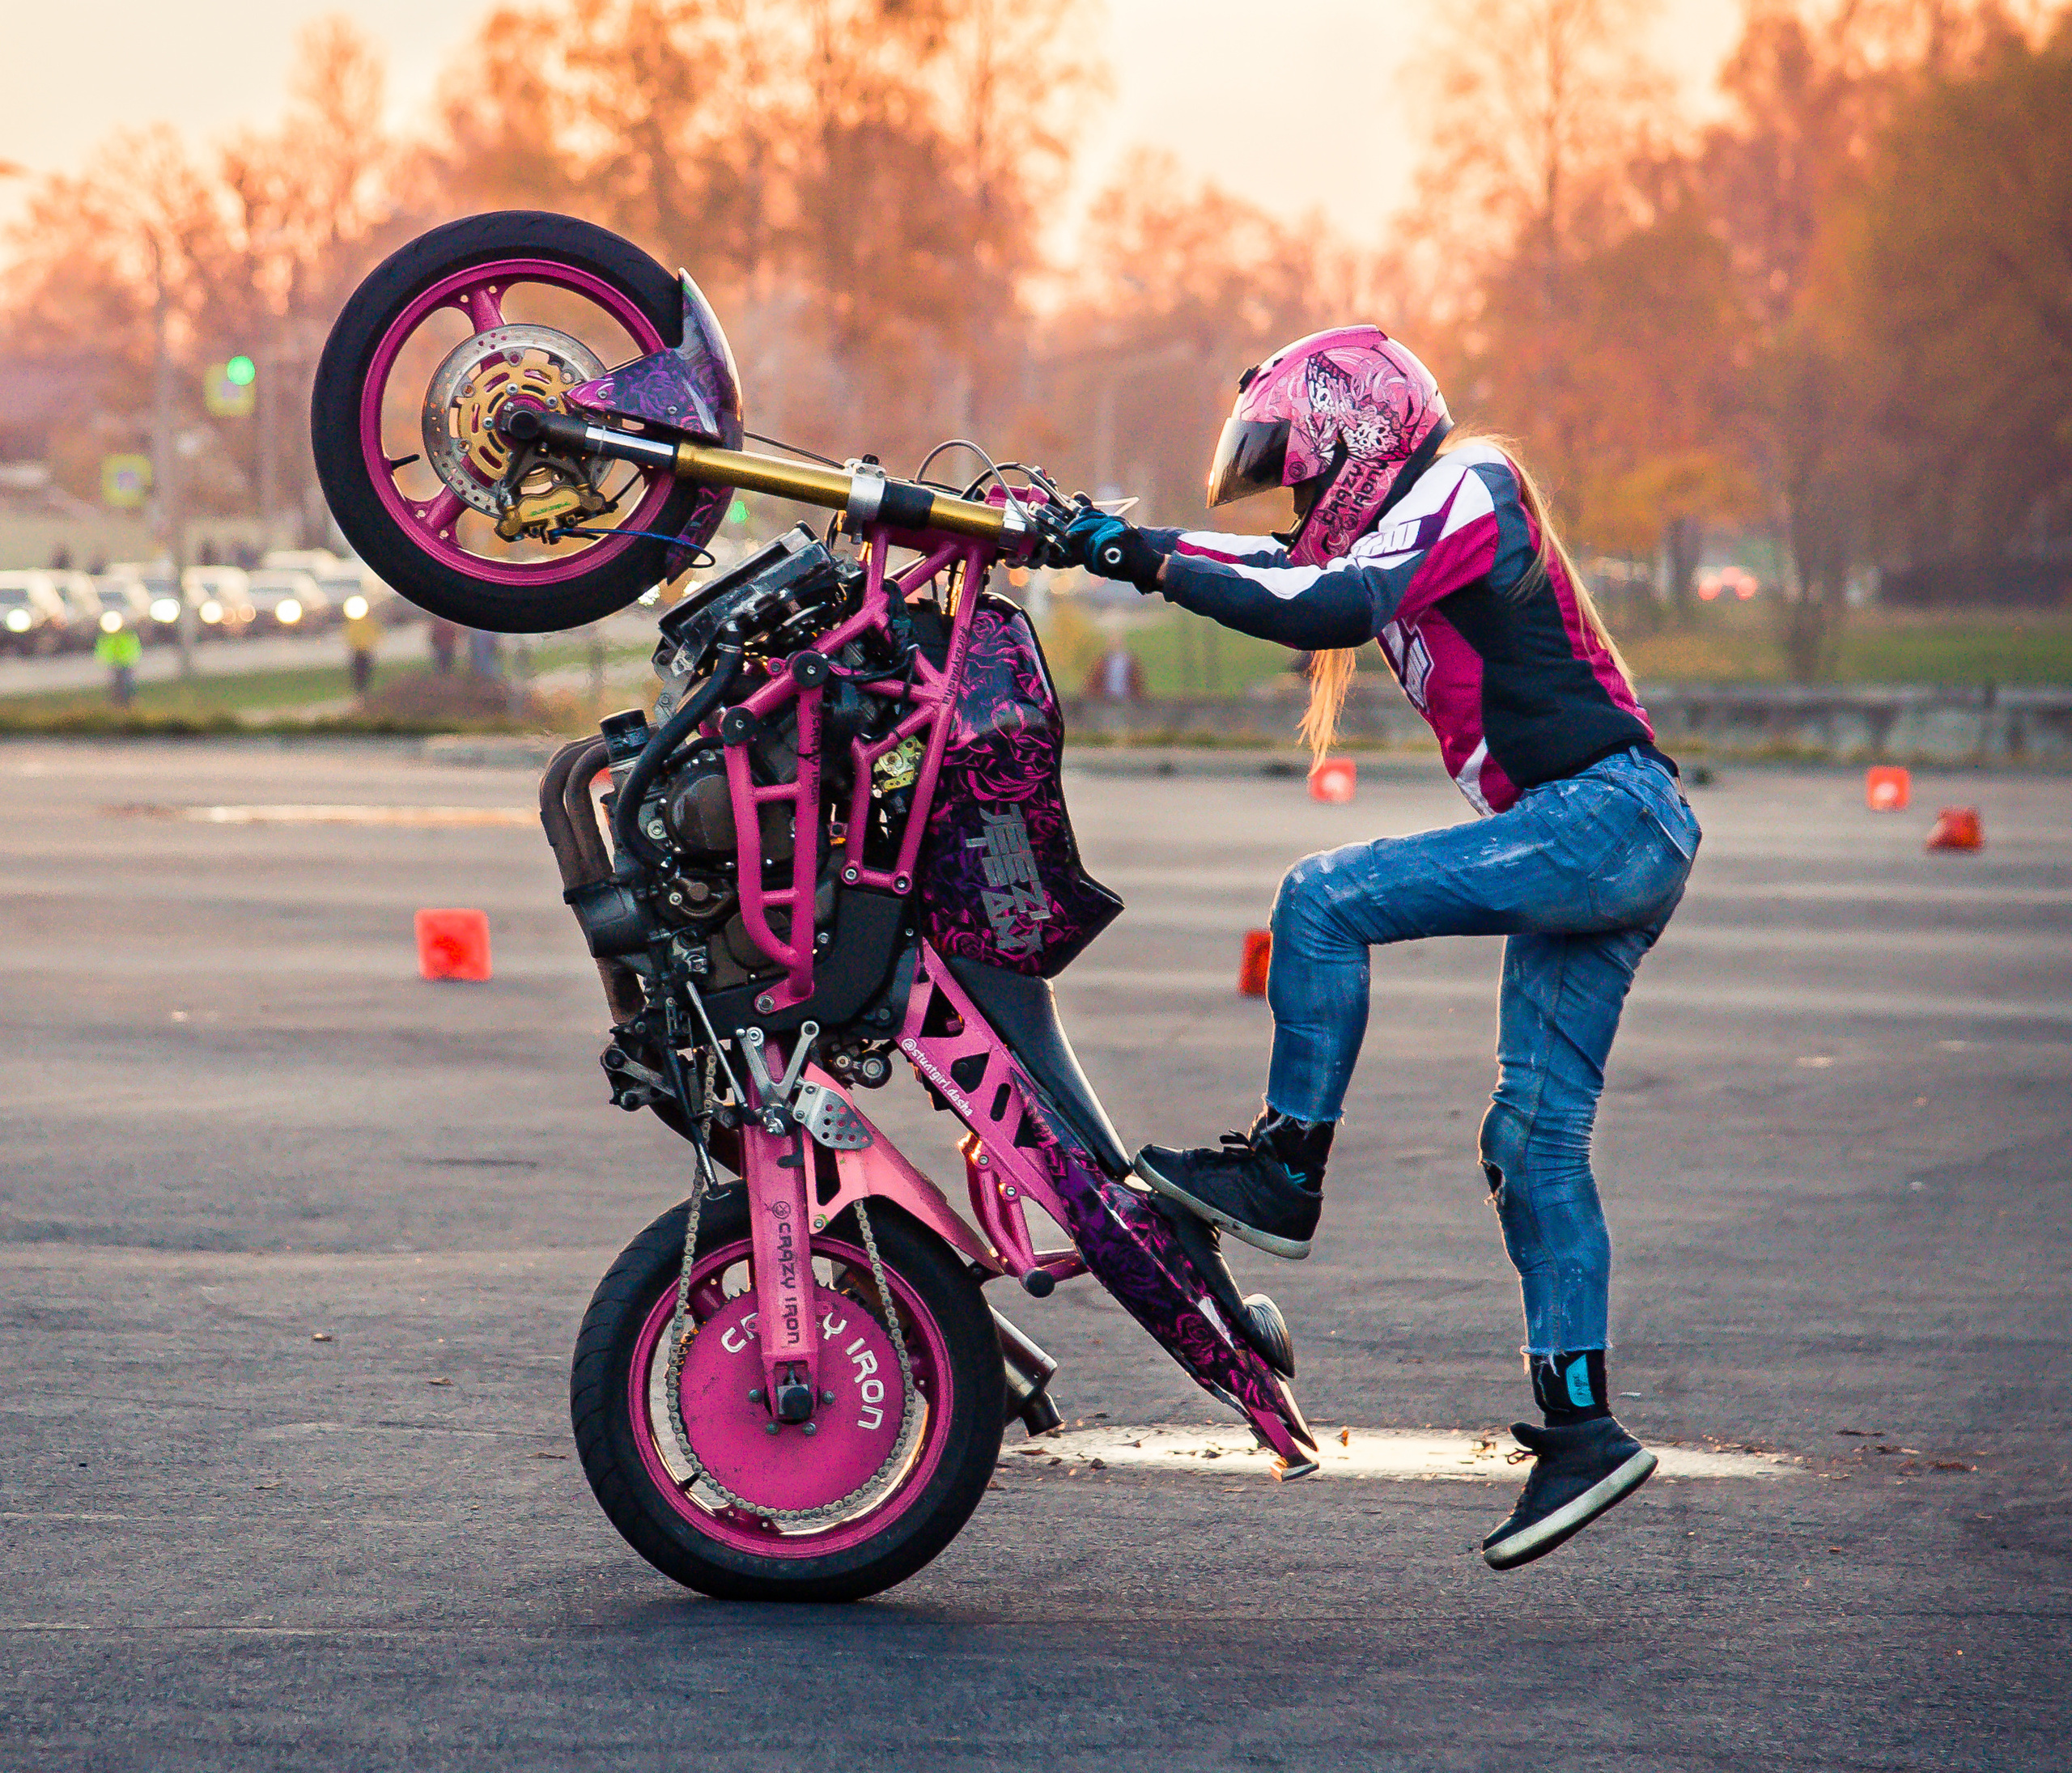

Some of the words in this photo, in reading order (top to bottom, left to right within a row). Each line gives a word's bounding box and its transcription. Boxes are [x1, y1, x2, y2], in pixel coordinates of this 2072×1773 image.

[1322, 464, 1363, 524] CRAZY
[901, 1037, 974, 1118] @stuntgirl.dasha
[775, 1221, 796, 1291] CRAZY
[784, 1296, 800, 1345] IRON
[845, 1337, 885, 1431] IRON
